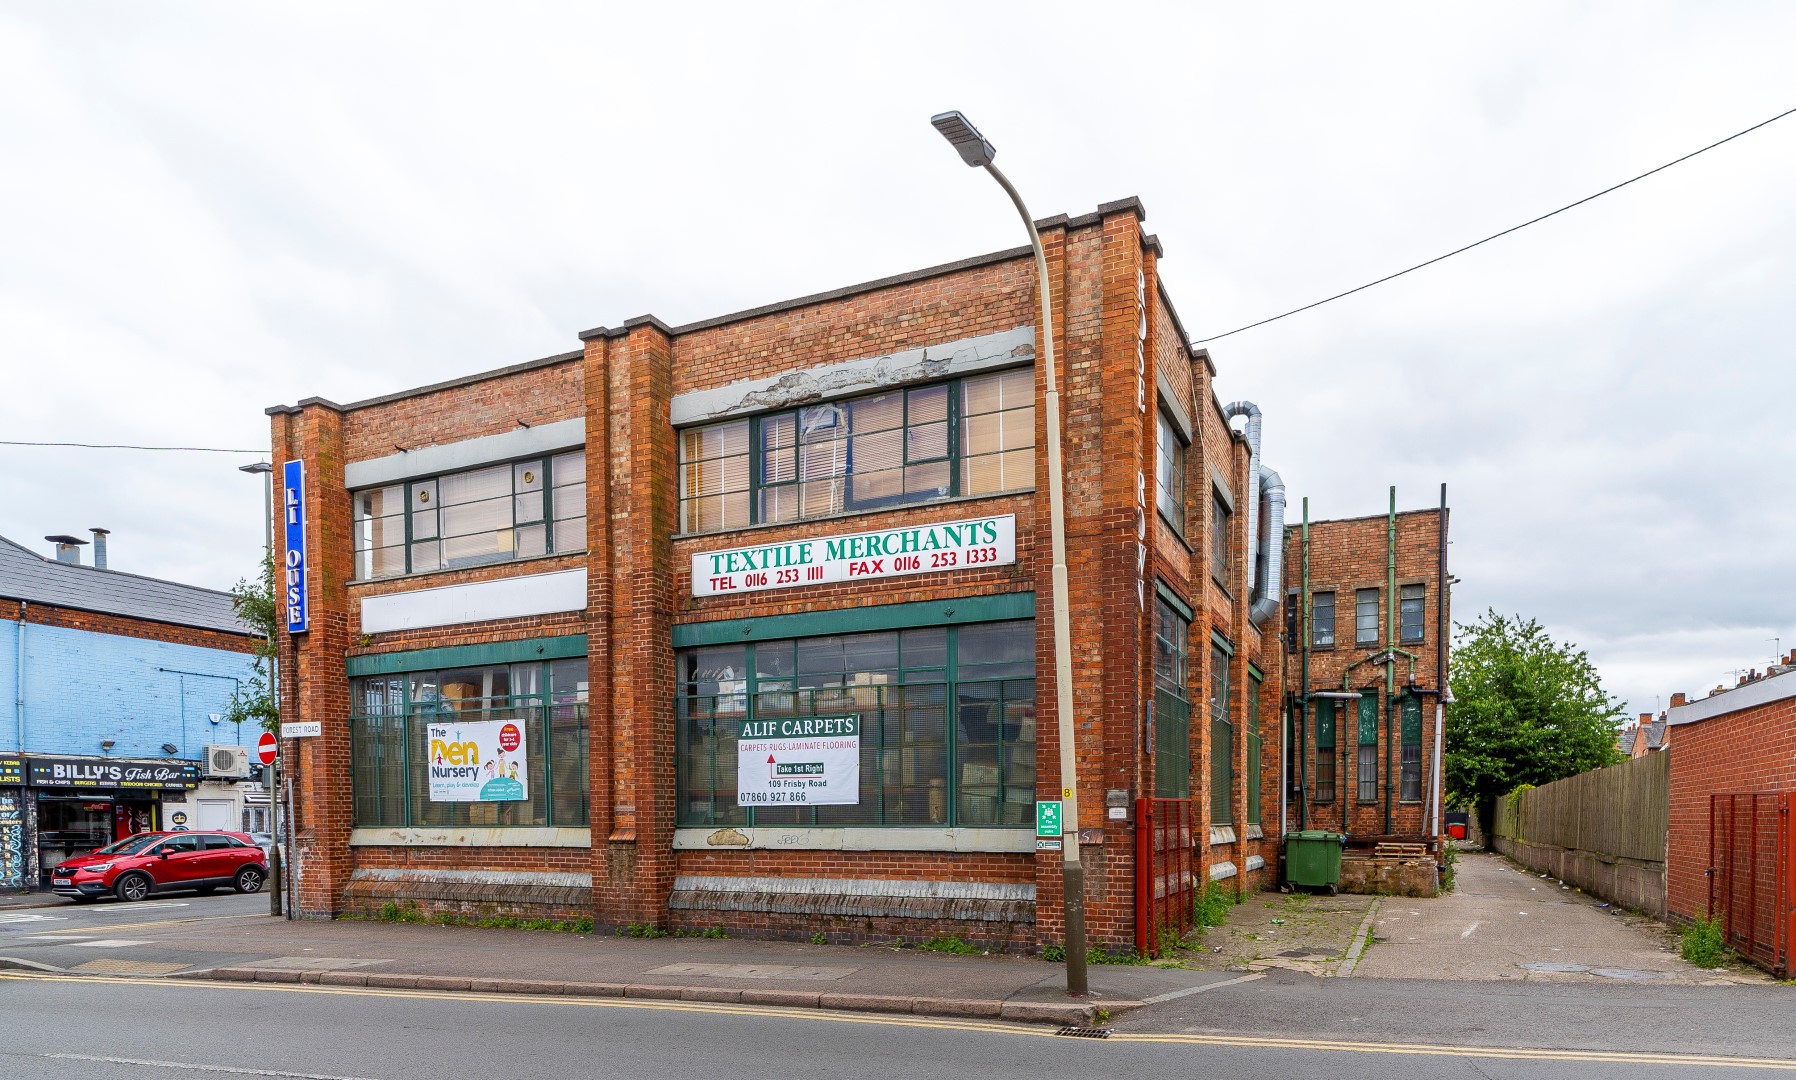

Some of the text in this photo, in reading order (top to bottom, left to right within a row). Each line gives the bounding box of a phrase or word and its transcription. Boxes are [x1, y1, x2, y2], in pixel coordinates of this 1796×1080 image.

[710, 520, 997, 575] TEXTILE MERCHANTS
[709, 576, 737, 591] TEL
[745, 573, 768, 588] 0116
[776, 568, 799, 584] 253
[849, 559, 884, 577] FAX
[894, 555, 921, 572] 0116
[931, 551, 957, 568] 253
[966, 547, 997, 565] 1333
[287, 549, 303, 624] OUSE
[303, 725, 319, 733] ROAD
[431, 728, 446, 737] The
[742, 718, 854, 737] ALIF CARPETS
[431, 739, 479, 766] Den
[740, 743, 767, 752] CARPETS
[822, 740, 857, 750] FLOORING
[53, 764, 180, 781] BILLY'S Fish Bar
[432, 766, 479, 781] Nursery
[777, 763, 823, 774] Take 1st Right
[768, 779, 827, 789] 109 Frisby Road
[740, 792, 806, 802] 07860 927 866
[1064, 789, 1070, 797] 8
